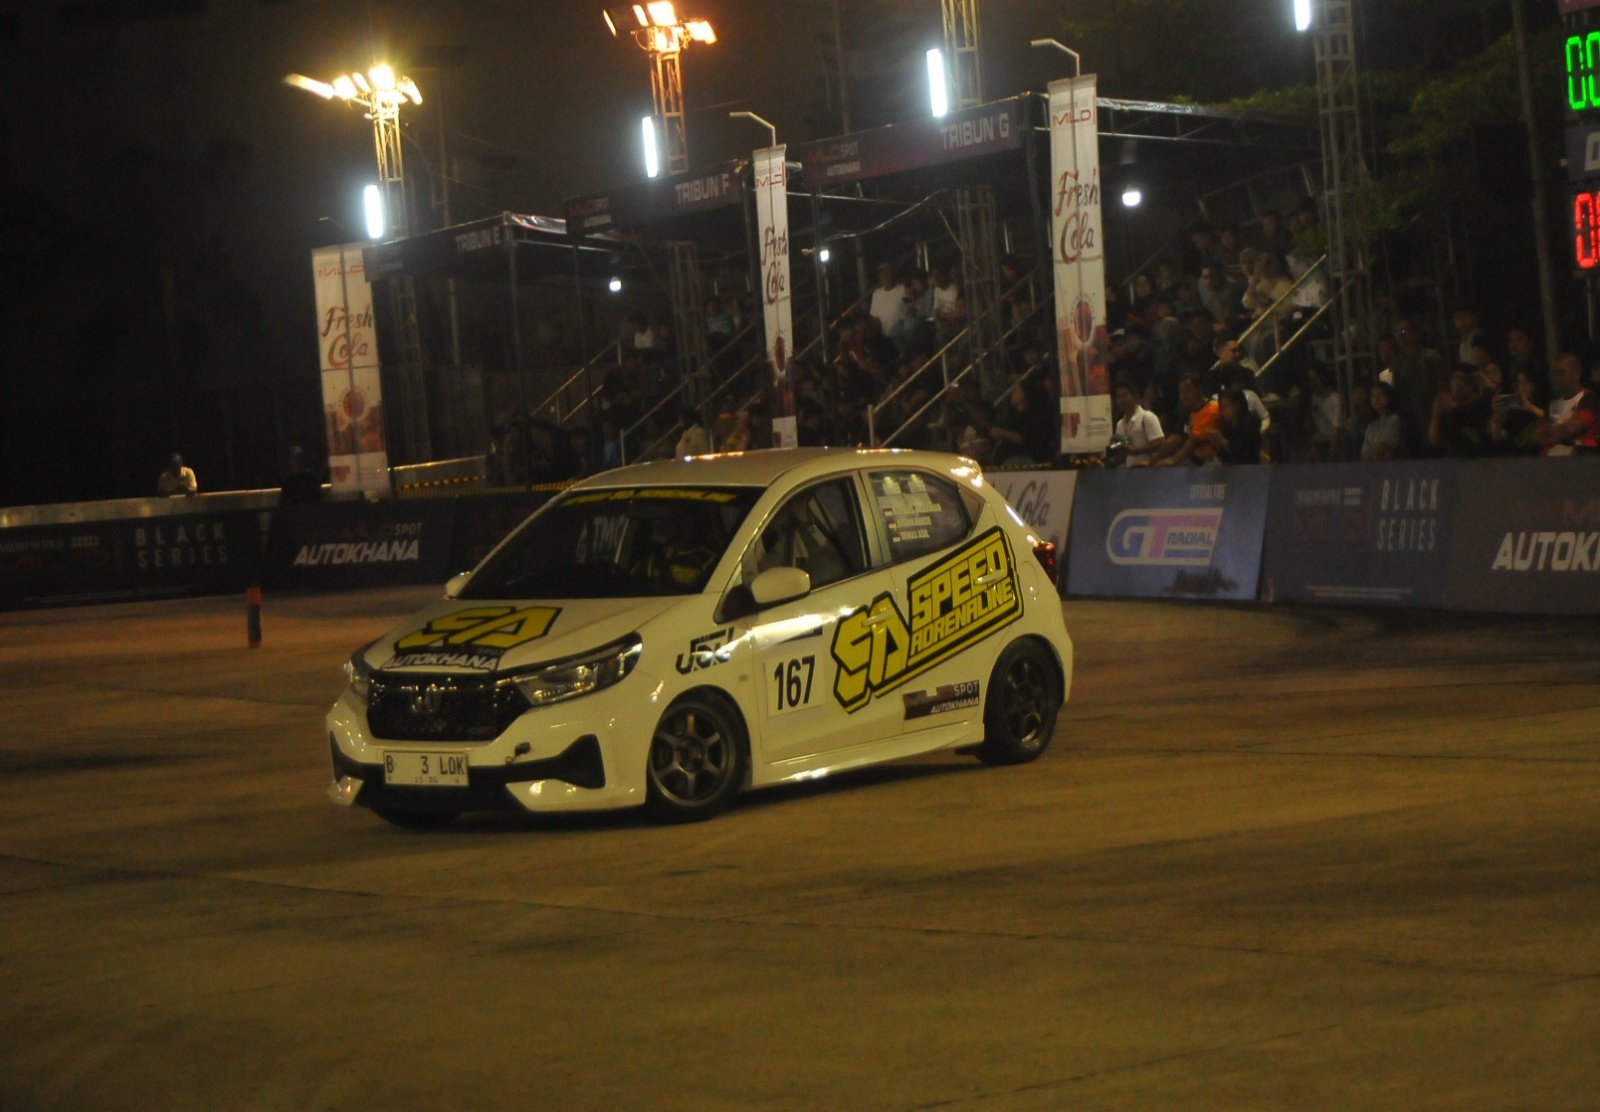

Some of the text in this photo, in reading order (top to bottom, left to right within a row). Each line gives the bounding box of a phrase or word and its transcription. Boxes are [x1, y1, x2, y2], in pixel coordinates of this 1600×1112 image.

[940, 112, 1010, 150] TRIBUN G
[675, 172, 730, 205] TRIBUN F
[1054, 167, 1099, 217] Fresh
[455, 227, 492, 253] TRIBUN
[1060, 211, 1095, 265] Cola
[1574, 191, 1600, 269] 0
[322, 302, 372, 338] Fresh
[328, 331, 370, 370] Cola
[1380, 478, 1439, 511] BLACK
[134, 522, 226, 547] BLACK
[1108, 511, 1221, 562] GT
[1376, 518, 1437, 551] SERIES
[138, 544, 229, 569] SERIES
[293, 539, 419, 566] AUTOKHANA
[911, 538, 1008, 632] SPEED
[911, 577, 1014, 656] ADRENALINE
[382, 652, 499, 672] AUTOKHANA
[773, 654, 816, 711] 167
[953, 682, 979, 697] SPOT
[385, 754, 466, 776] B 3 LOK
